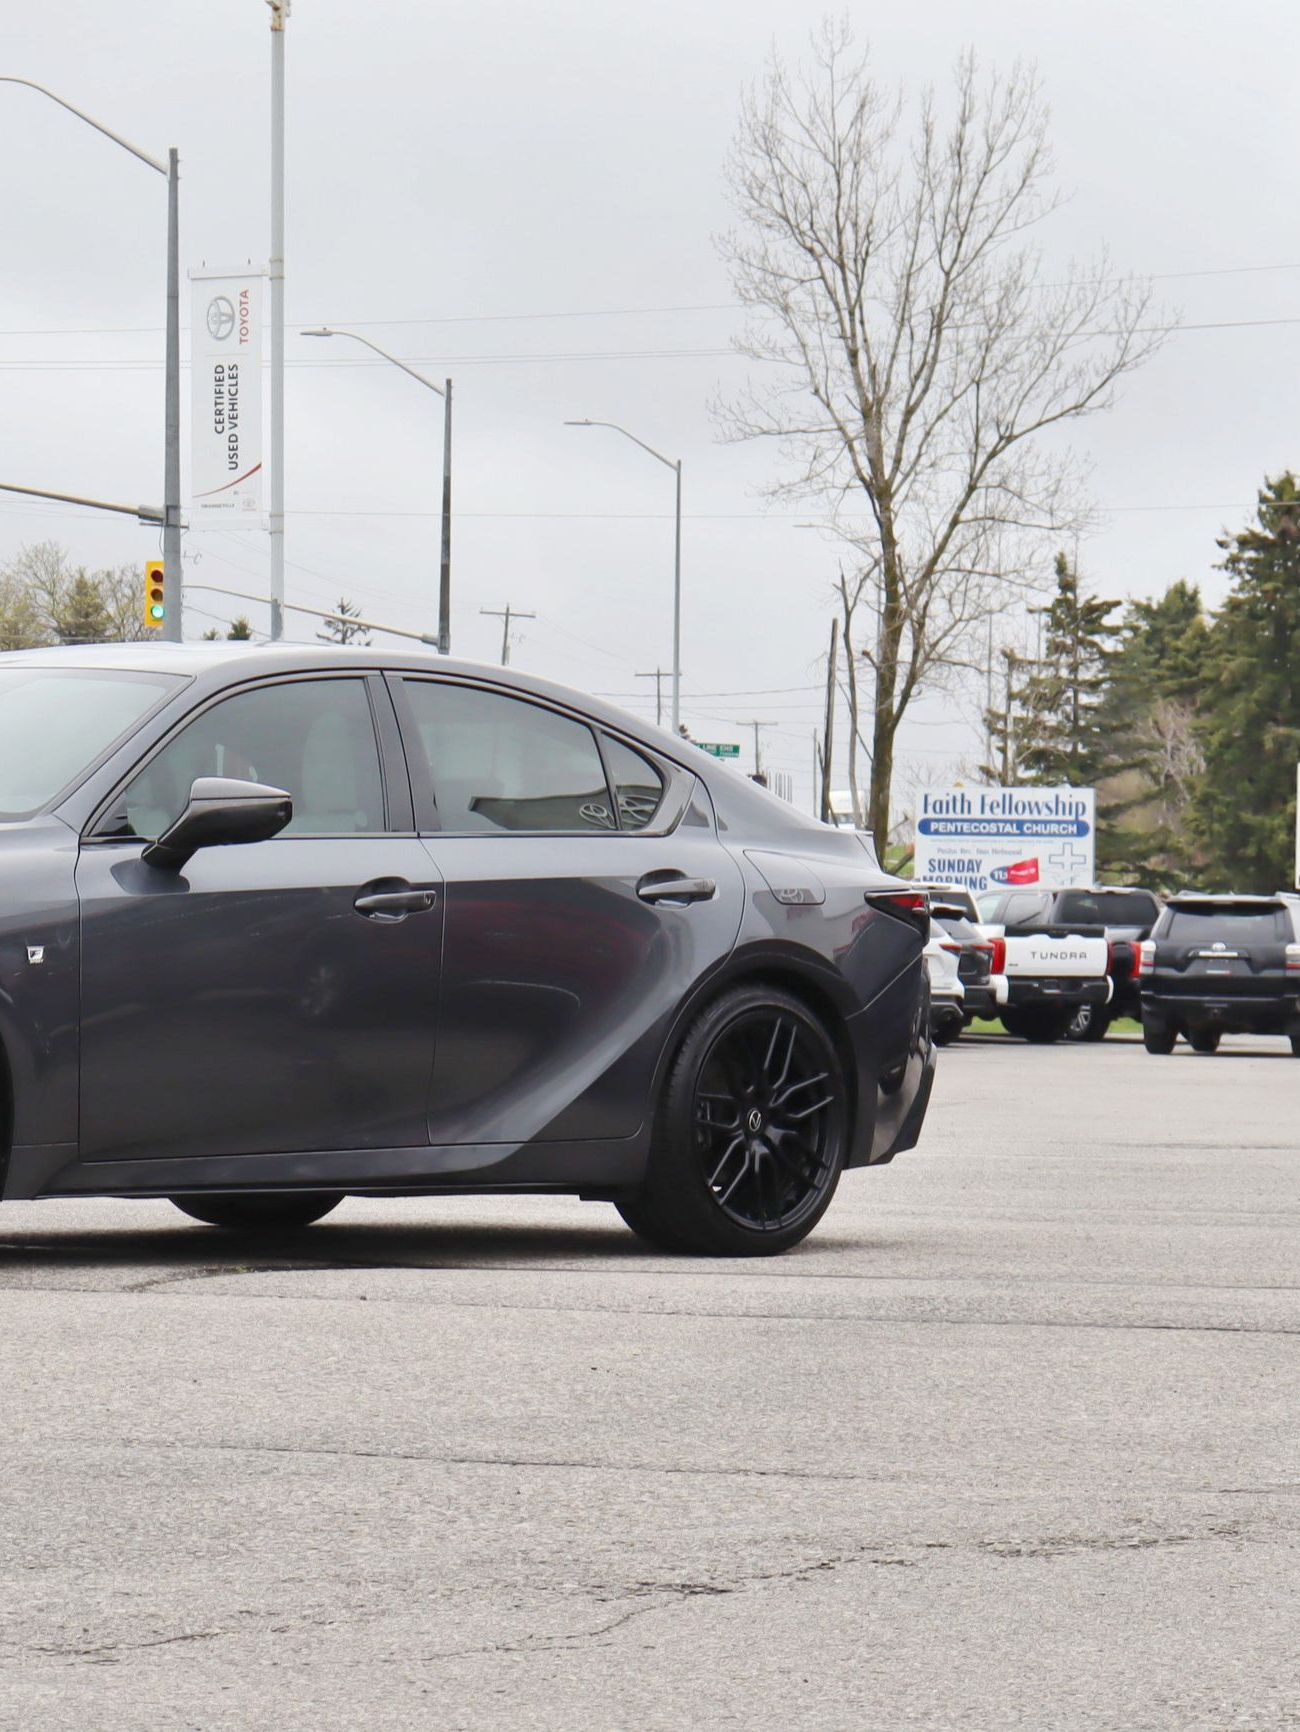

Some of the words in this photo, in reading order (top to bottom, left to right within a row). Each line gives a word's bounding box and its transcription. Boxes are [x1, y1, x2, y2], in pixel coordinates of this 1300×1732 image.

[239, 289, 249, 344] TOYOTA
[214, 364, 224, 434] CERTIFIED
[228, 364, 238, 430] VEHICLES
[228, 433, 238, 470] USED
[923, 793, 971, 815] Faith
[980, 793, 1086, 820] Fellowship
[930, 822, 1020, 834] PENTECOSTAL
[1023, 823, 1077, 834] CHURCH
[928, 858, 982, 873] SUNDAY
[1030, 951, 1087, 960] TUNDRA
